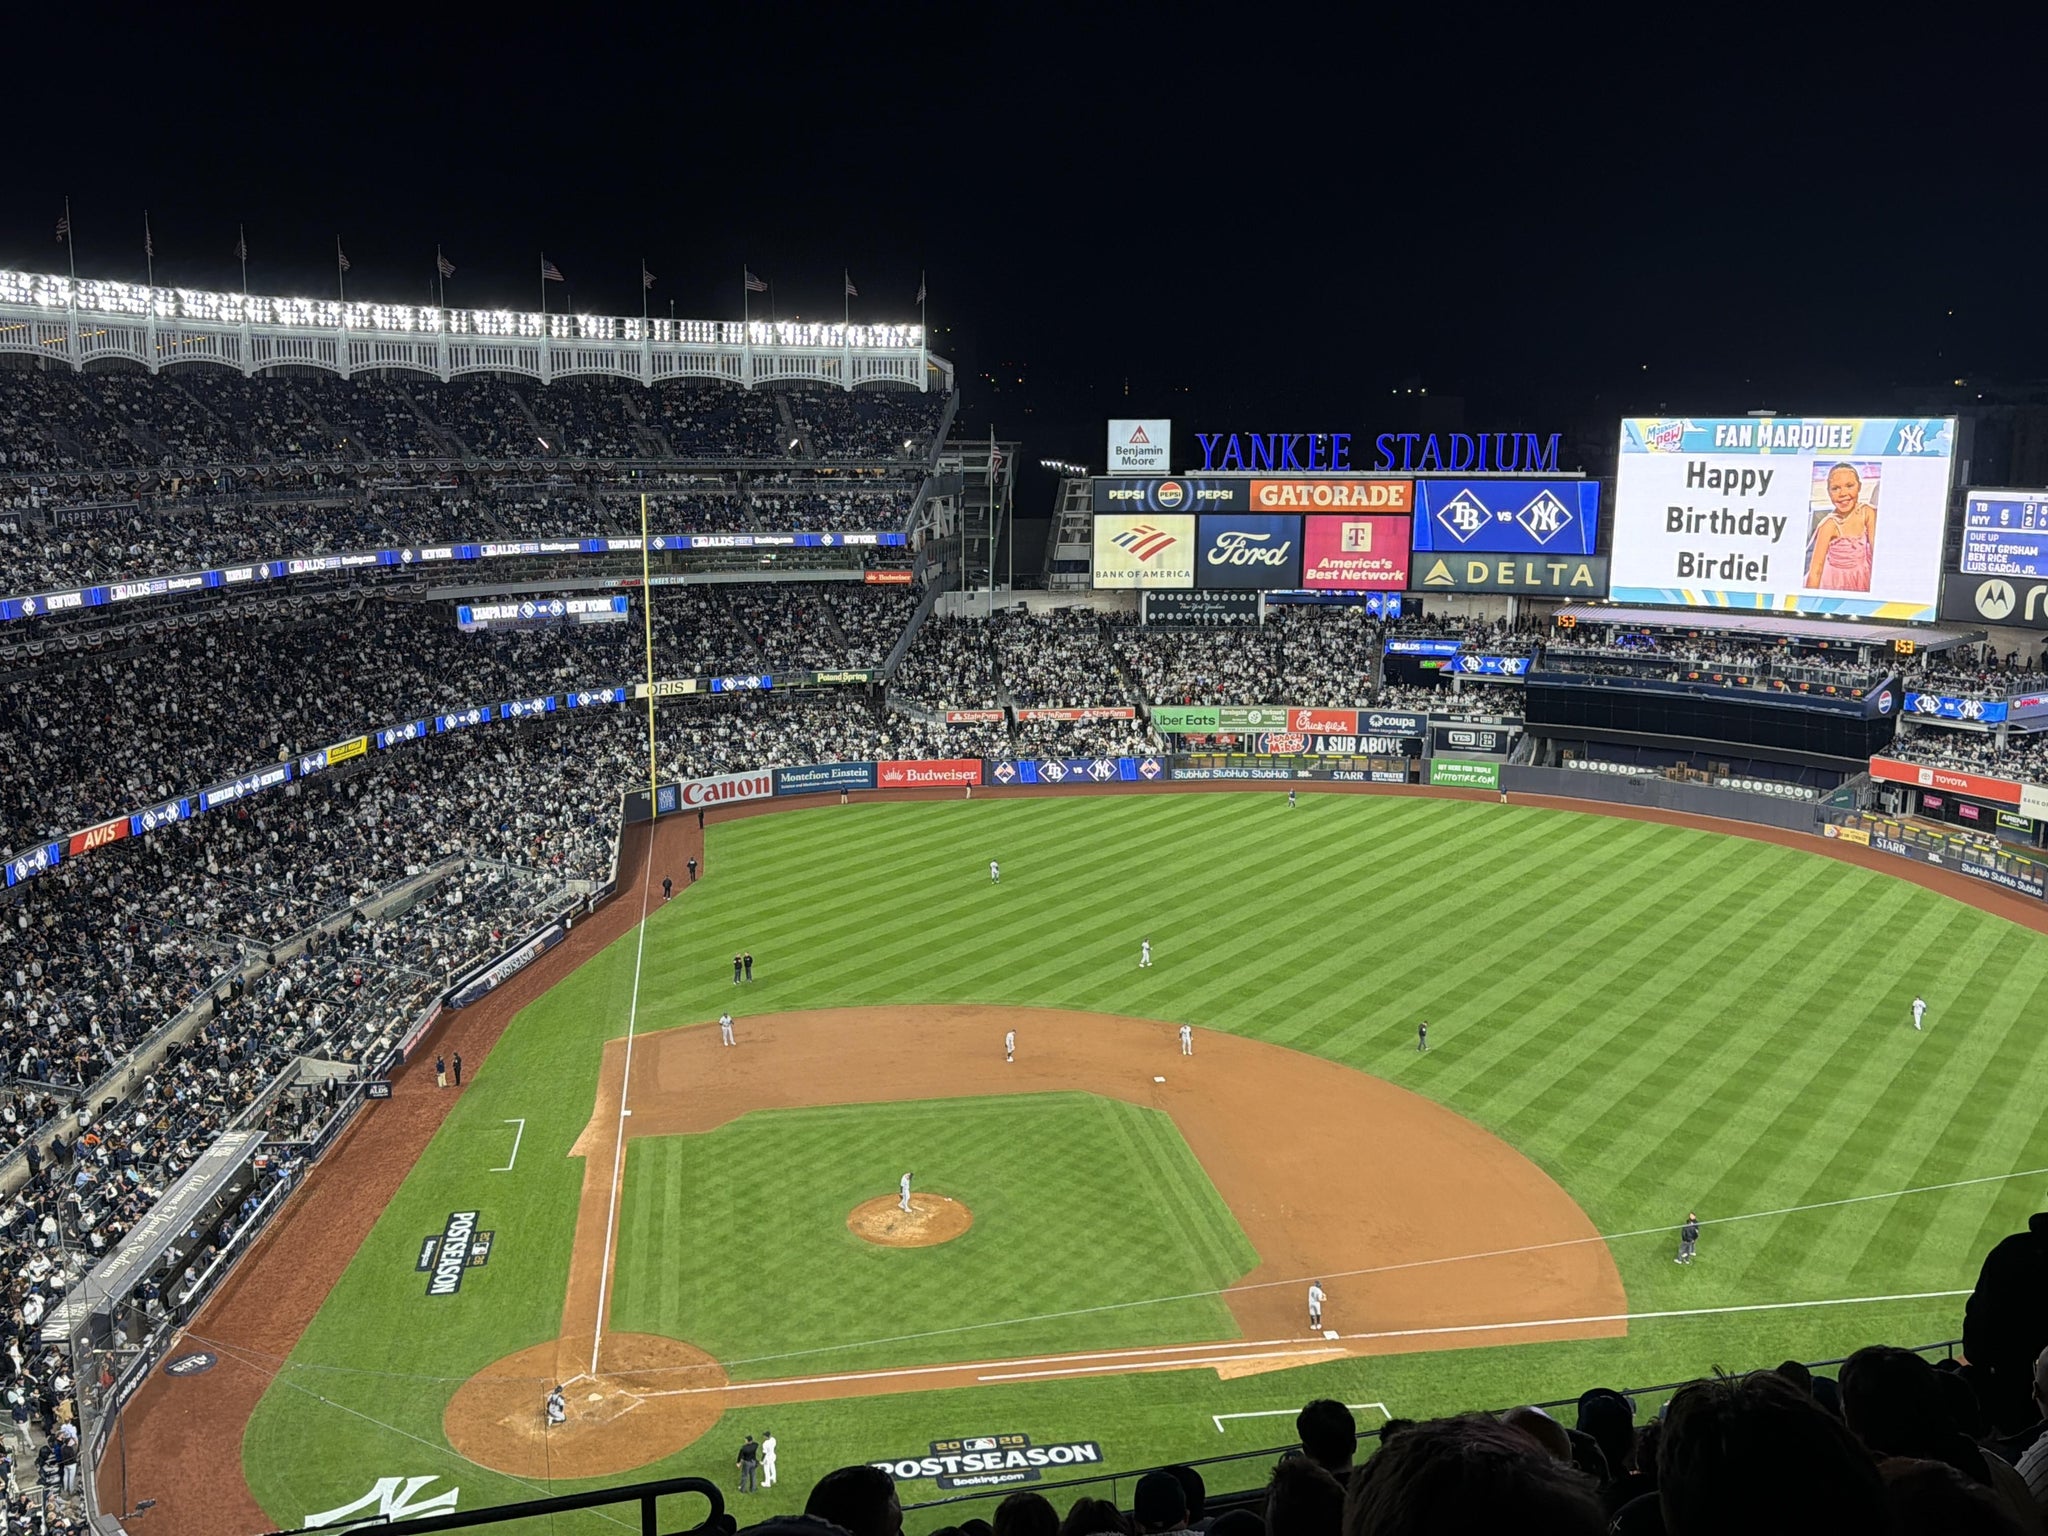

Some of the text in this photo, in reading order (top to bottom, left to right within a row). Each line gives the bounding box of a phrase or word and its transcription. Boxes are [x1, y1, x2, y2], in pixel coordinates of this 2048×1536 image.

[1715, 424, 1852, 449] FAN MARQUEE
[1115, 445, 1163, 458] Benjamin
[1195, 433, 1562, 472] YANKEE STADIUM
[1121, 455, 1156, 467] Moore
[1686, 461, 1774, 496] Happy
[1108, 488, 1145, 501] PEPSI
[1160, 491, 1181, 499] PEPSI
[1196, 488, 1233, 500] PEPSI
[1259, 484, 1404, 507] GATORADE
[1449, 501, 1479, 530] TB
[1530, 500, 1560, 531] NY
[1976, 502, 1988, 512] TB
[2026, 504, 2034, 515] 2
[1666, 506, 1788, 543] Birthday
[1971, 515, 1991, 526] NYY
[2025, 516, 2033, 528] 2
[1970, 532, 1999, 543] DUE UP
[1206, 531, 1291, 567] Ford
[1968, 543, 2039, 557] TRENT GRISHAM
[1317, 557, 1393, 571] America's
[1967, 552, 2008, 565] BEN RICE
[1467, 561, 1595, 587] DELTA
[1677, 551, 1769, 583] Birdie!
[1967, 561, 2037, 576] LUIS GARCÍA JR.
[878, 574, 912, 582] Budweiser
[1095, 569, 1192, 580] BANK OF AMERICA
[1306, 569, 1405, 582] Best Network
[620, 579, 641, 587] Audi
[472, 606, 501, 621] TAMPA
[500, 605, 519, 619] BAY
[816, 671, 868, 684] Poland Spring
[1154, 714, 1185, 726] Uber
[1185, 714, 1216, 726] Eats
[1383, 717, 1416, 730] coupa
[1267, 733, 1305, 747] Jersey
[1315, 736, 1404, 754] A SUB ABOVE
[1452, 734, 1471, 742] YES
[780, 767, 869, 783] Montefiore Einstein
[906, 767, 978, 783] Budweiser
[1174, 769, 1210, 780] StubHub
[1213, 769, 1249, 779] StubHub
[1251, 769, 1289, 780] StubHub
[1333, 771, 1364, 781] STARR
[1433, 771, 1496, 786] NITTOTIRE.COM
[1935, 774, 1968, 788] TOYOTA
[682, 776, 770, 805] Canon
[2023, 797, 2041, 806] BANK
[2000, 814, 2029, 827] ARENA
[83, 827, 116, 850] AVIS
[1876, 838, 1907, 855] STARR
[1961, 861, 2043, 898] StubHub StubHub StubHub
[496, 946, 535, 982] POSTSEASON
[430, 1211, 476, 1295] POSTSEASON
[99, 1243, 145, 1279] Stadium
[935, 1435, 1024, 1451] 20 26
[871, 1443, 1098, 1478] POSTSEASON
[953, 1472, 1025, 1487] Booking.com
